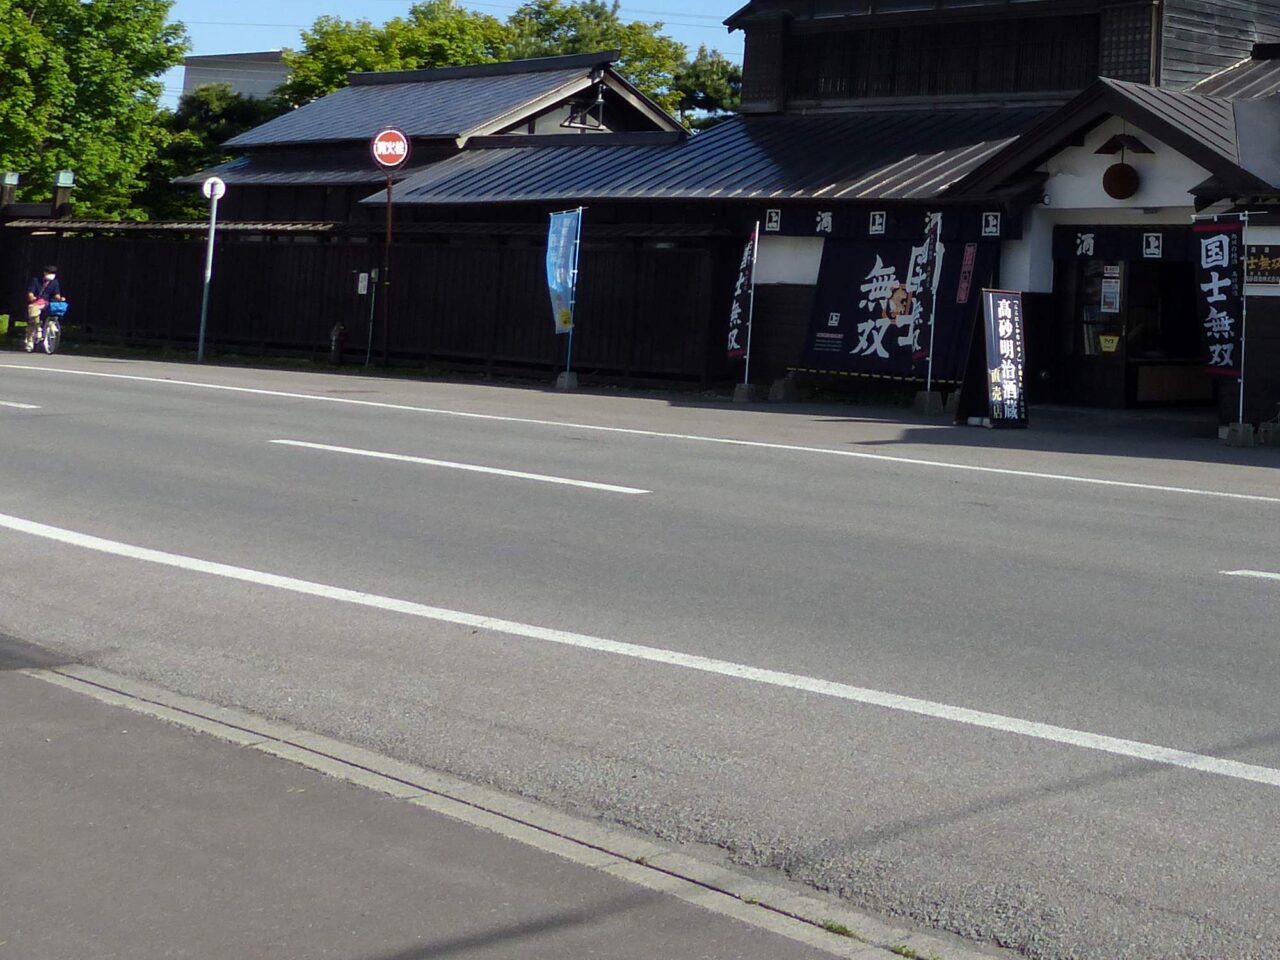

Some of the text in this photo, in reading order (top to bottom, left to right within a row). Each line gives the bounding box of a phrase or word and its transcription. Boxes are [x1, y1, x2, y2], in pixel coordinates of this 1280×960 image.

[816, 211, 832, 233] 酒
[1076, 233, 1094, 256] 酒
[1201, 234, 1235, 367] 国士無双
